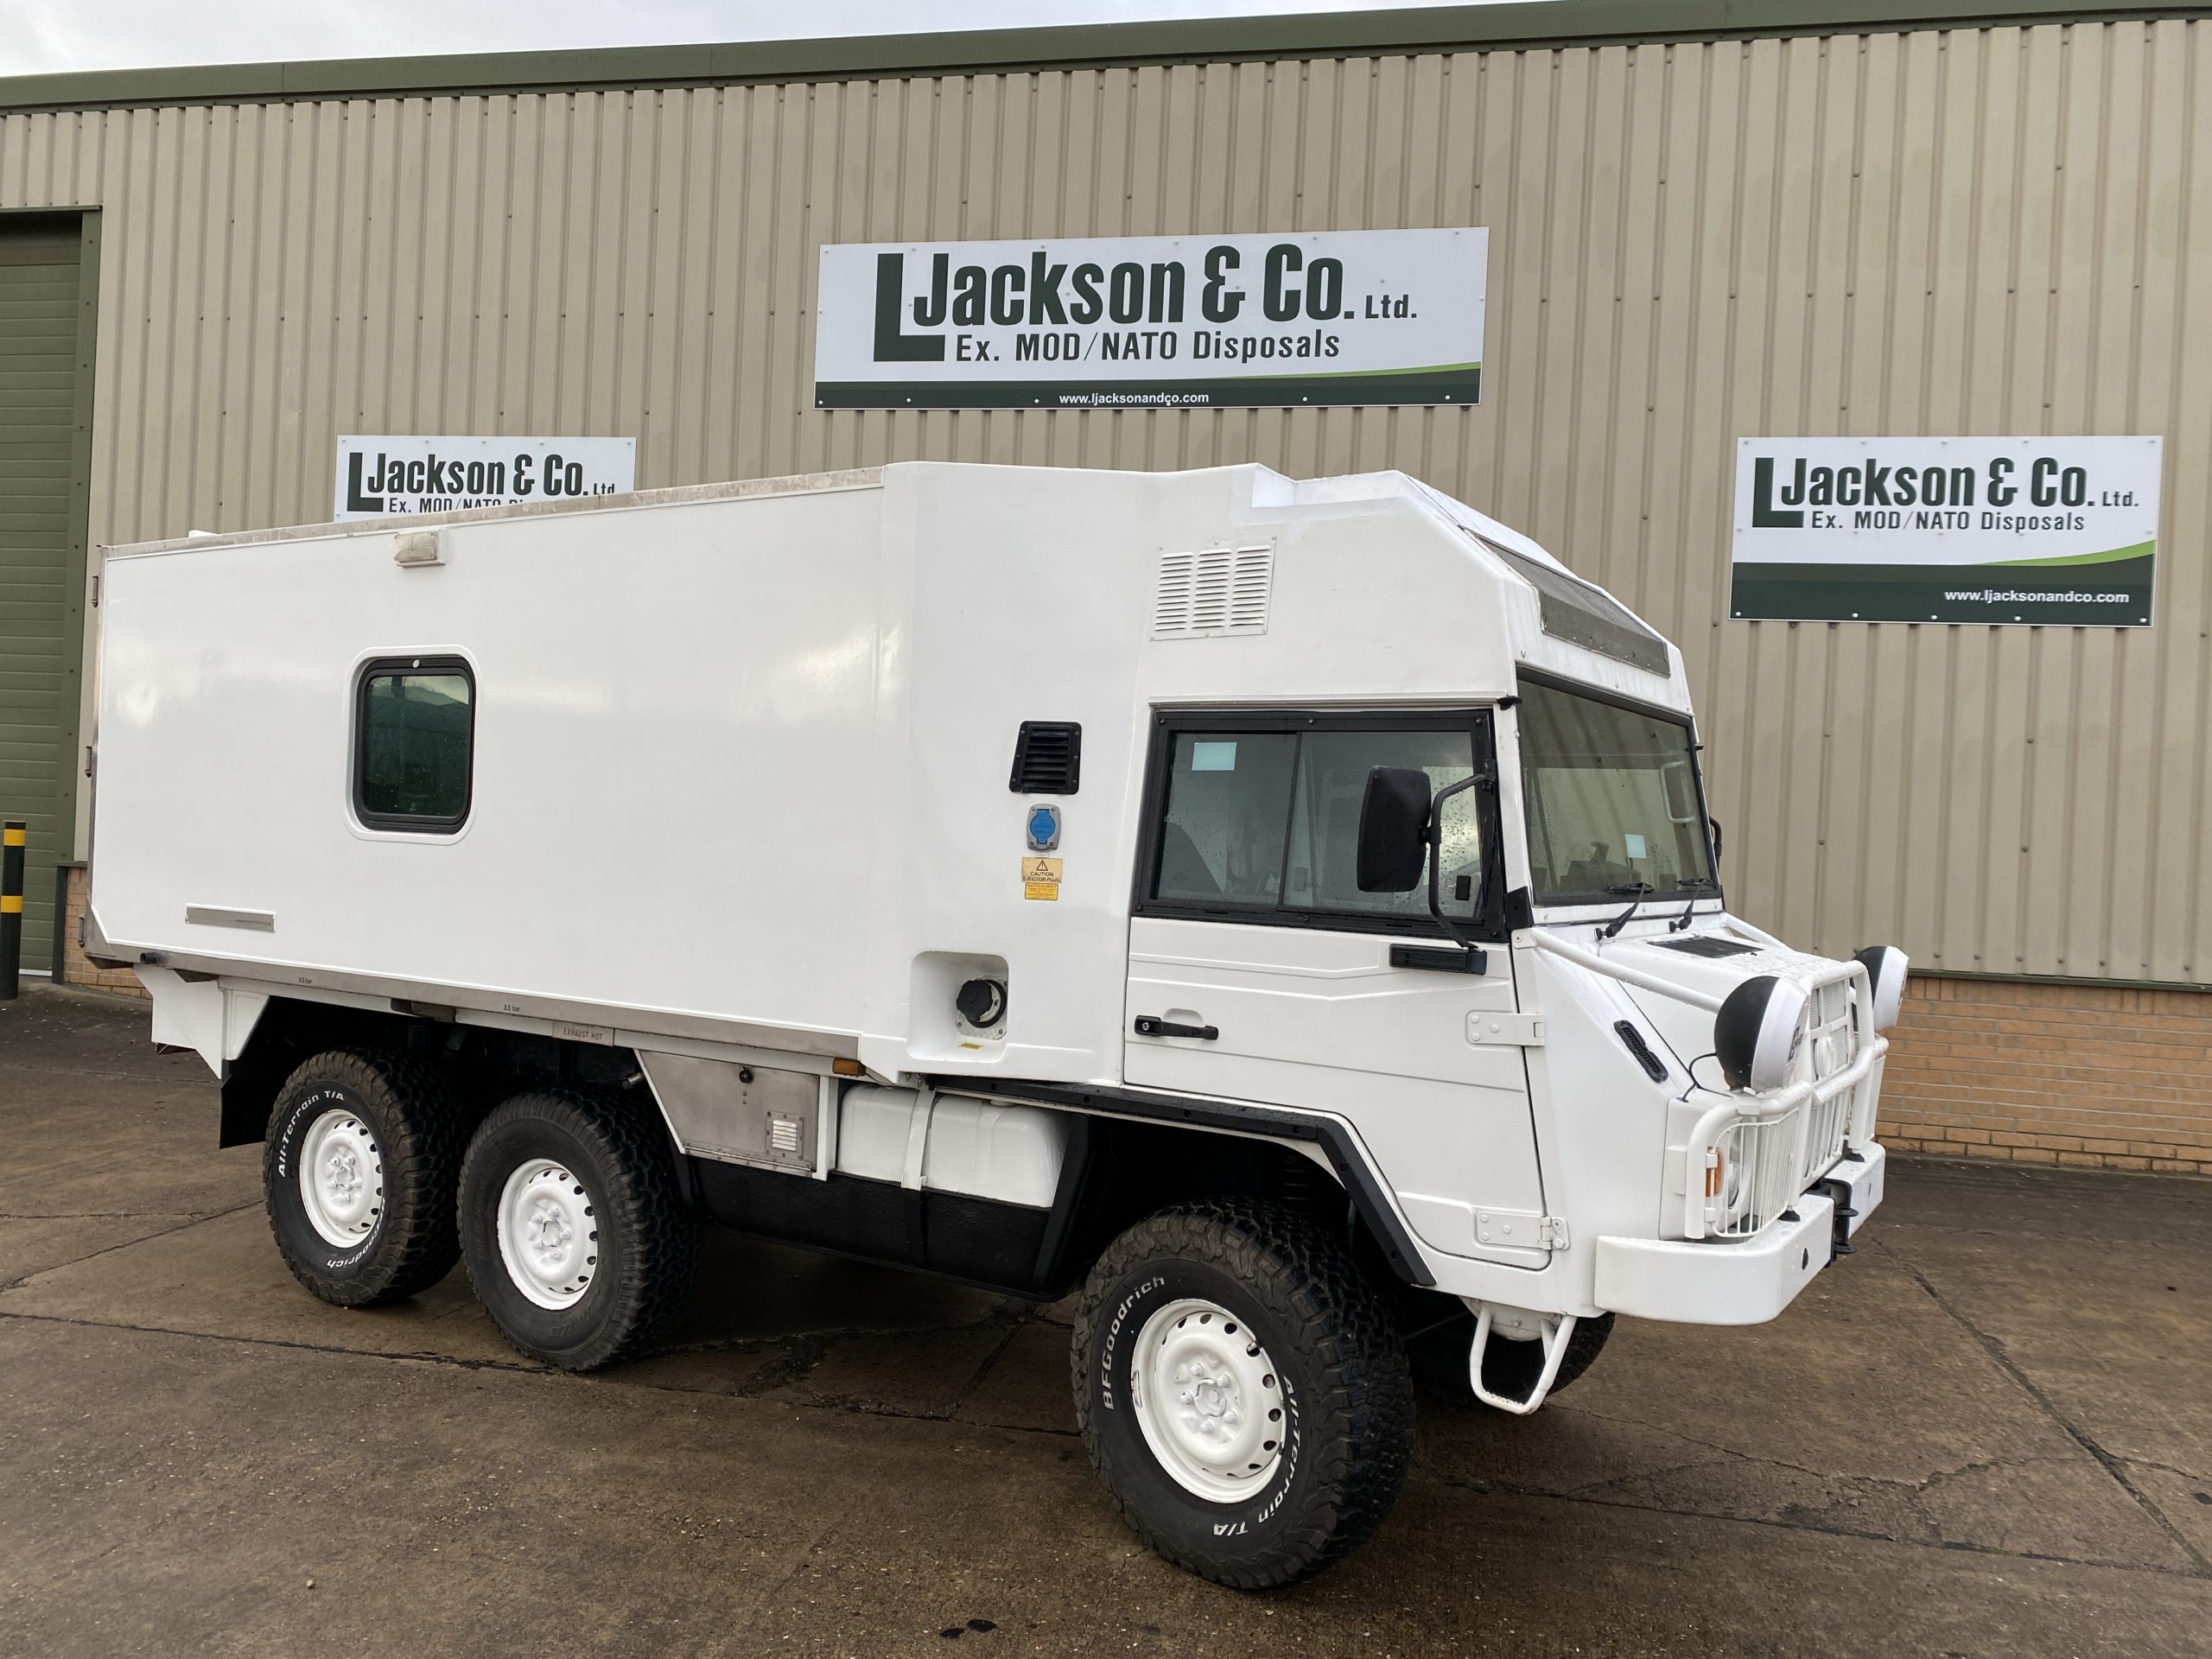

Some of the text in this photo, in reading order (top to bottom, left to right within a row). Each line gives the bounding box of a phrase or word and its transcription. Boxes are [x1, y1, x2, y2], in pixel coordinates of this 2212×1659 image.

[1201, 245, 1246, 324] &
[1262, 243, 1355, 322] Co.
[1364, 293, 1418, 319] Ltd.
[956, 328, 1340, 364] Ex. MOD/NATO Disposals
[1058, 391, 1210, 405] www.ljacksonandco.com
[512, 454, 535, 495] &
[543, 454, 588, 496] Co.
[1987, 456, 2018, 507] &
[2031, 456, 2095, 507] Co.
[2102, 490, 2140, 507] Ltd.
[388, 497, 412, 513] Ex.
[1811, 510, 2085, 534] Ex. MOD/NATO Disposals
[1944, 588, 2130, 605] www.ljacksonandco.com
[563, 1027, 602, 1041] EXHAUST HOT
[323, 1090, 344, 1101] T/A
[1102, 1275, 1166, 1411] BFGoodrich
[1213, 1521, 1249, 1536] T/A
